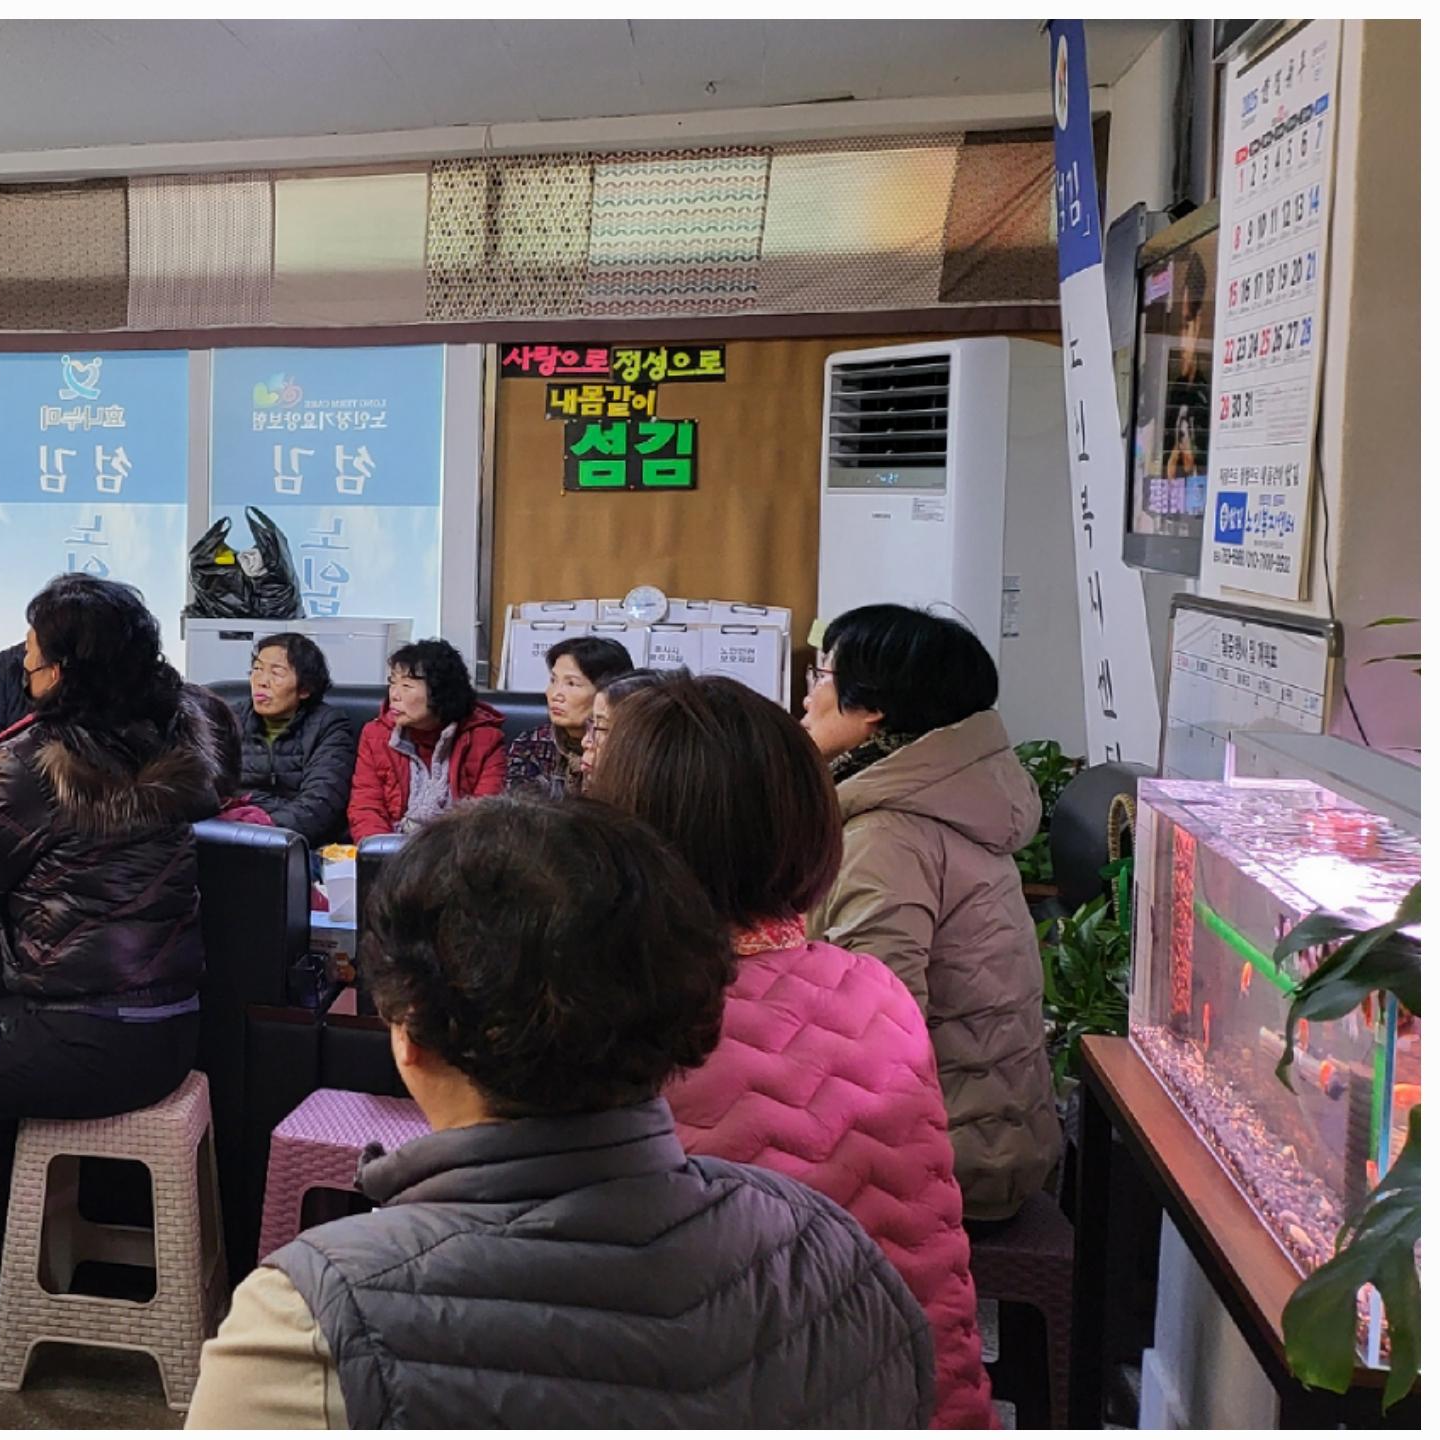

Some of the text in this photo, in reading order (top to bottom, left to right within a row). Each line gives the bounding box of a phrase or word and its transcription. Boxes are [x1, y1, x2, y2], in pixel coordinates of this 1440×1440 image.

[1258, 212, 1267, 239] 10
[1271, 206, 1278, 235] 11
[1282, 199, 1291, 228] 12
[1295, 192, 1304, 222] 13
[1308, 184, 1320, 215] 14
[1229, 251, 1316, 308] 15 16 17 18 19 20 21
[503, 346, 725, 382] 사랑으로 정성으로
[1223, 316, 1311, 364] 22 23 24 25 26 27 28
[550, 385, 657, 416] 내몸같이
[1220, 391, 1253, 420] 29 30 31
[570, 422, 694, 487] 섬김
